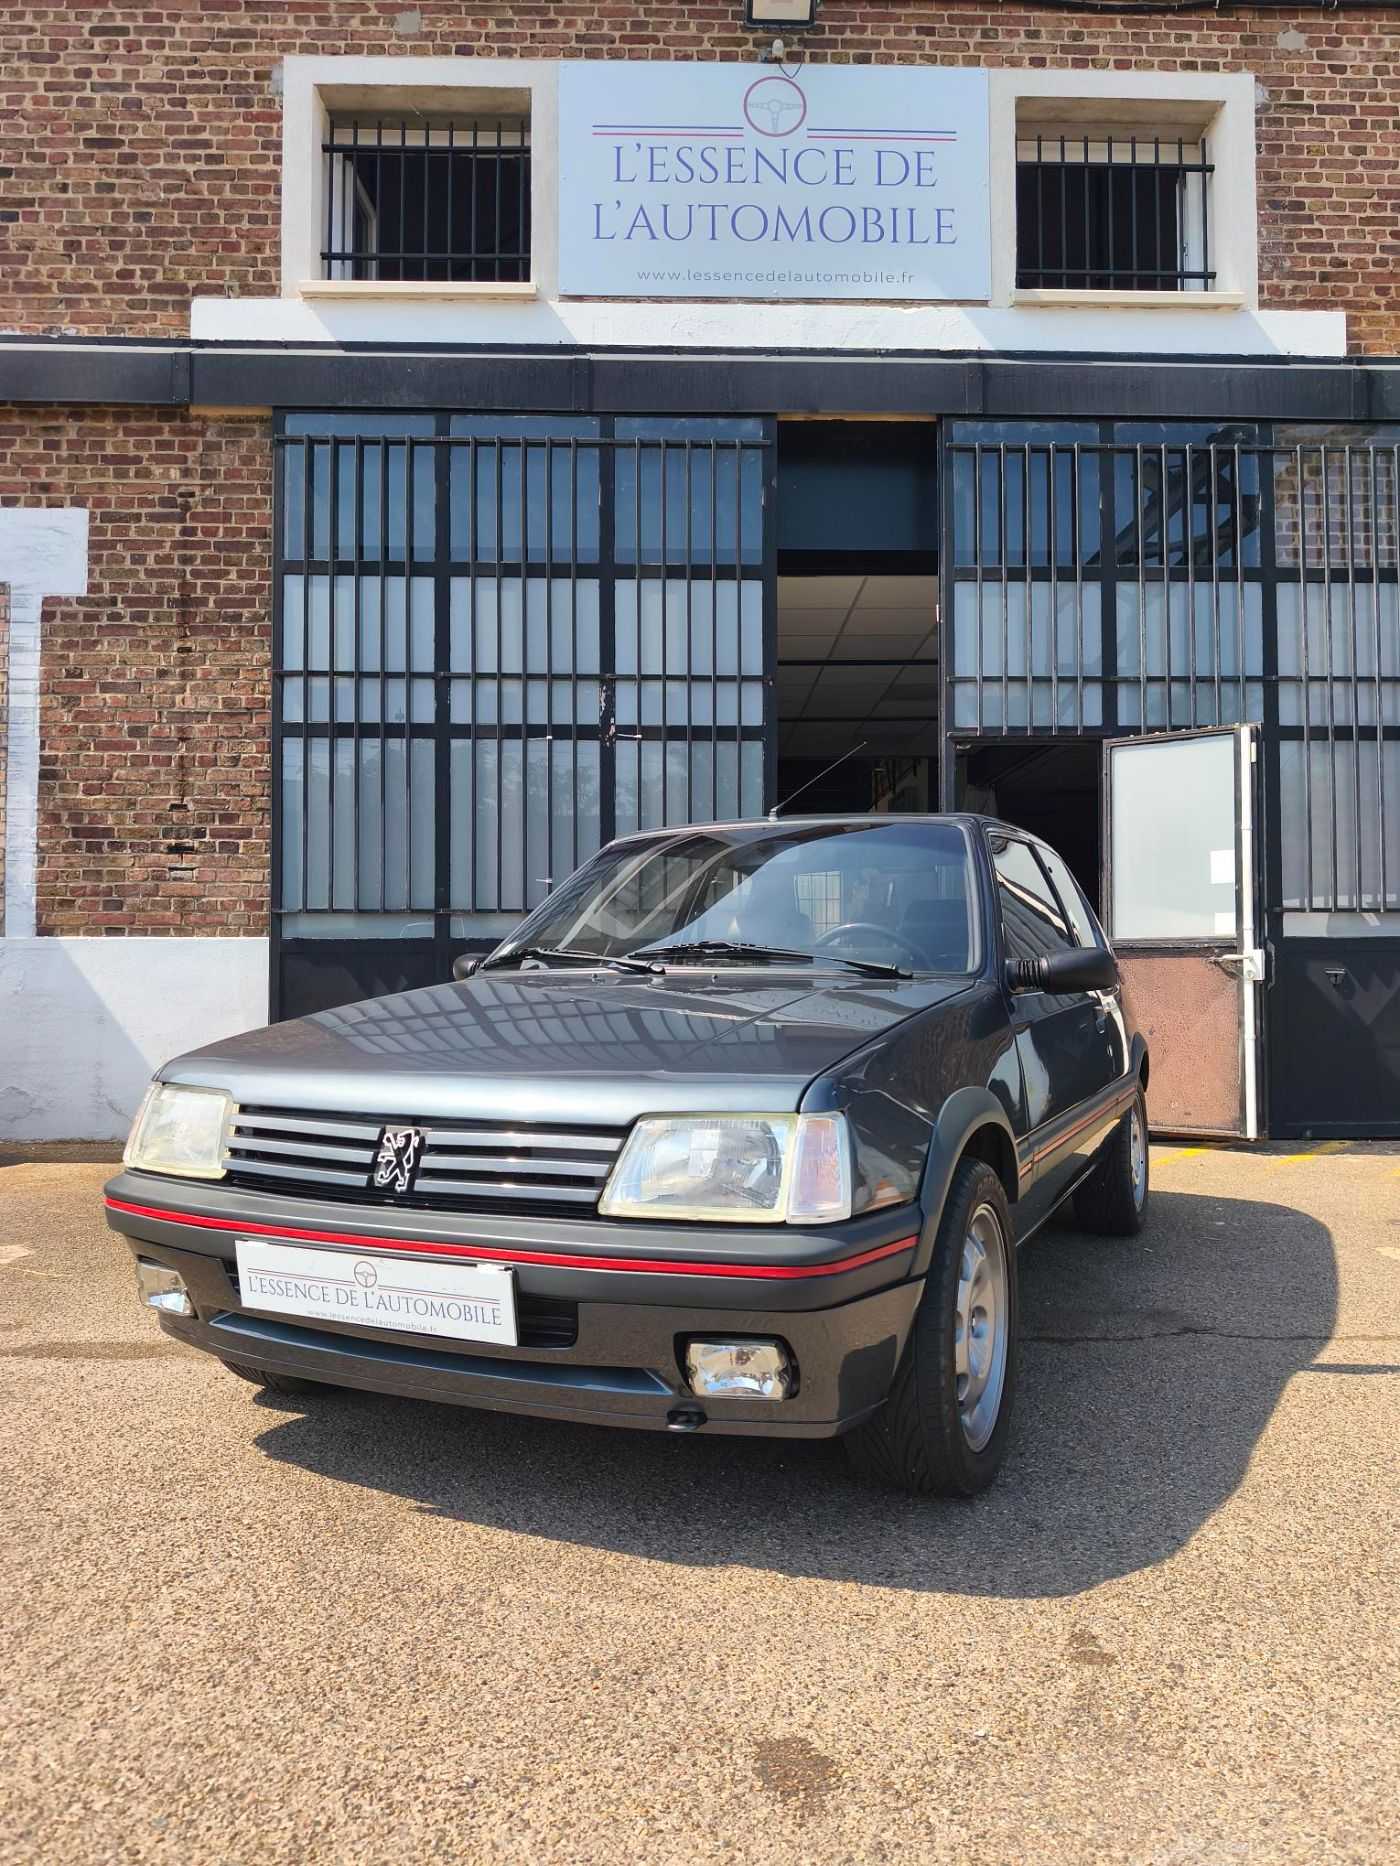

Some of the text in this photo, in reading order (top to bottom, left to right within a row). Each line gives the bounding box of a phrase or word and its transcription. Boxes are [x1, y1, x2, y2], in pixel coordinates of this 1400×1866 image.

[613, 144, 938, 188] L'ESSENCE DE
[593, 200, 958, 245] L'AUTOMOBILE
[637, 269, 915, 285] www.lessencedelautomobile.fr
[248, 1275, 503, 1326] L'ESSENCE DE L'AUTOMOBILE
